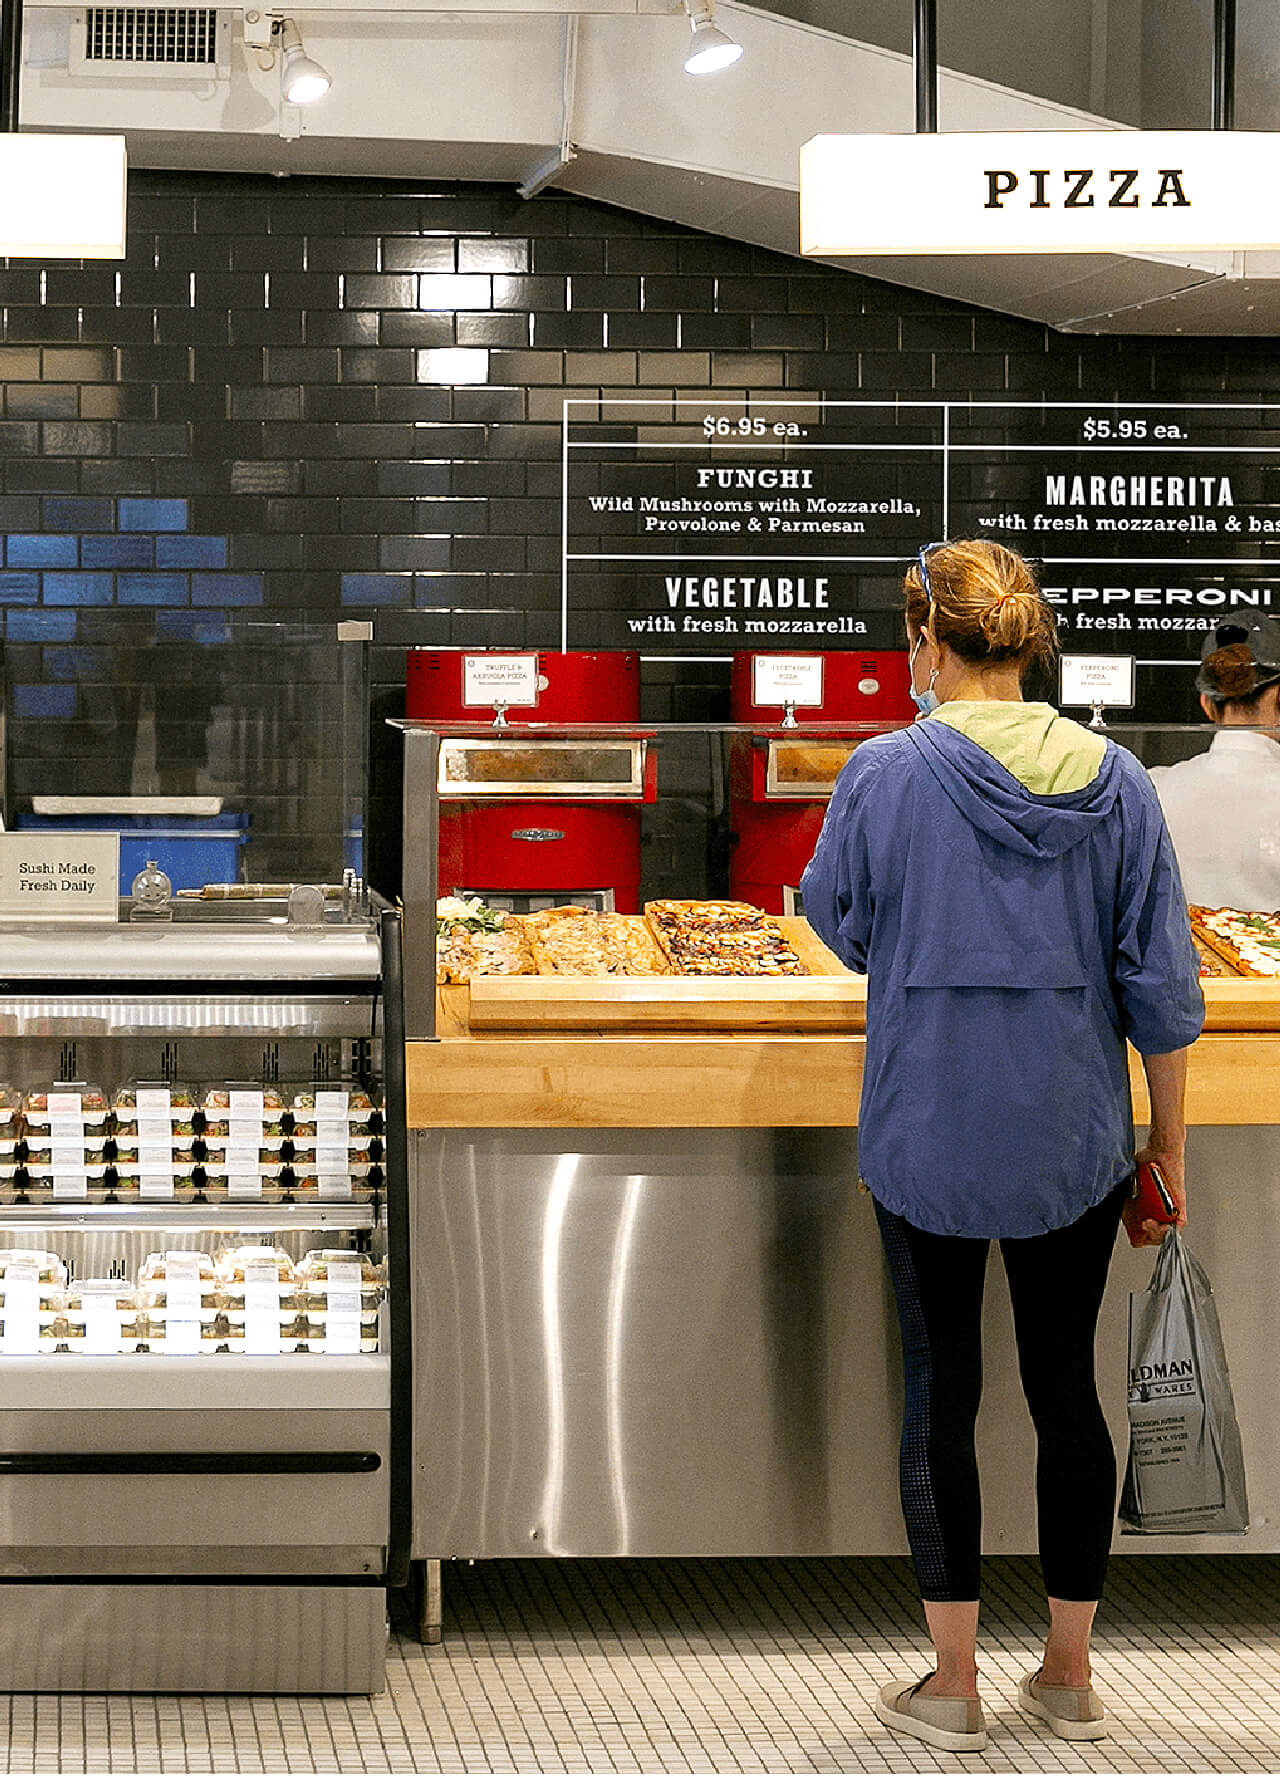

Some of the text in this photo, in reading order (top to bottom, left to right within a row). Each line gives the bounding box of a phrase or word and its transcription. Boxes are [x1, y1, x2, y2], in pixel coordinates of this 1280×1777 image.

[983, 169, 1191, 209] PIZZA
[703, 414, 808, 438] $6.95 ea.
[1083, 416, 1188, 441] $5.95 ea.
[696, 468, 813, 489] FUNGHI
[1046, 475, 1234, 507] MARGHERITA
[588, 496, 921, 517] Wild Mushrooms with Mozzarella,
[645, 516, 865, 533] Provolone & Parmesan
[979, 513, 1028, 530] with
[1033, 513, 1089, 531] fresh
[1095, 514, 1217, 532] mozzarella
[1224, 515, 1242, 532] &
[665, 577, 829, 608] VEGETABLE
[1040, 587, 1271, 605] EPPERONI
[627, 616, 868, 634] with fresh mozzarella
[1076, 612, 1132, 630] fresh
[19, 862, 96, 875] Sushi Made
[19, 879, 95, 894] Fresh Daily
